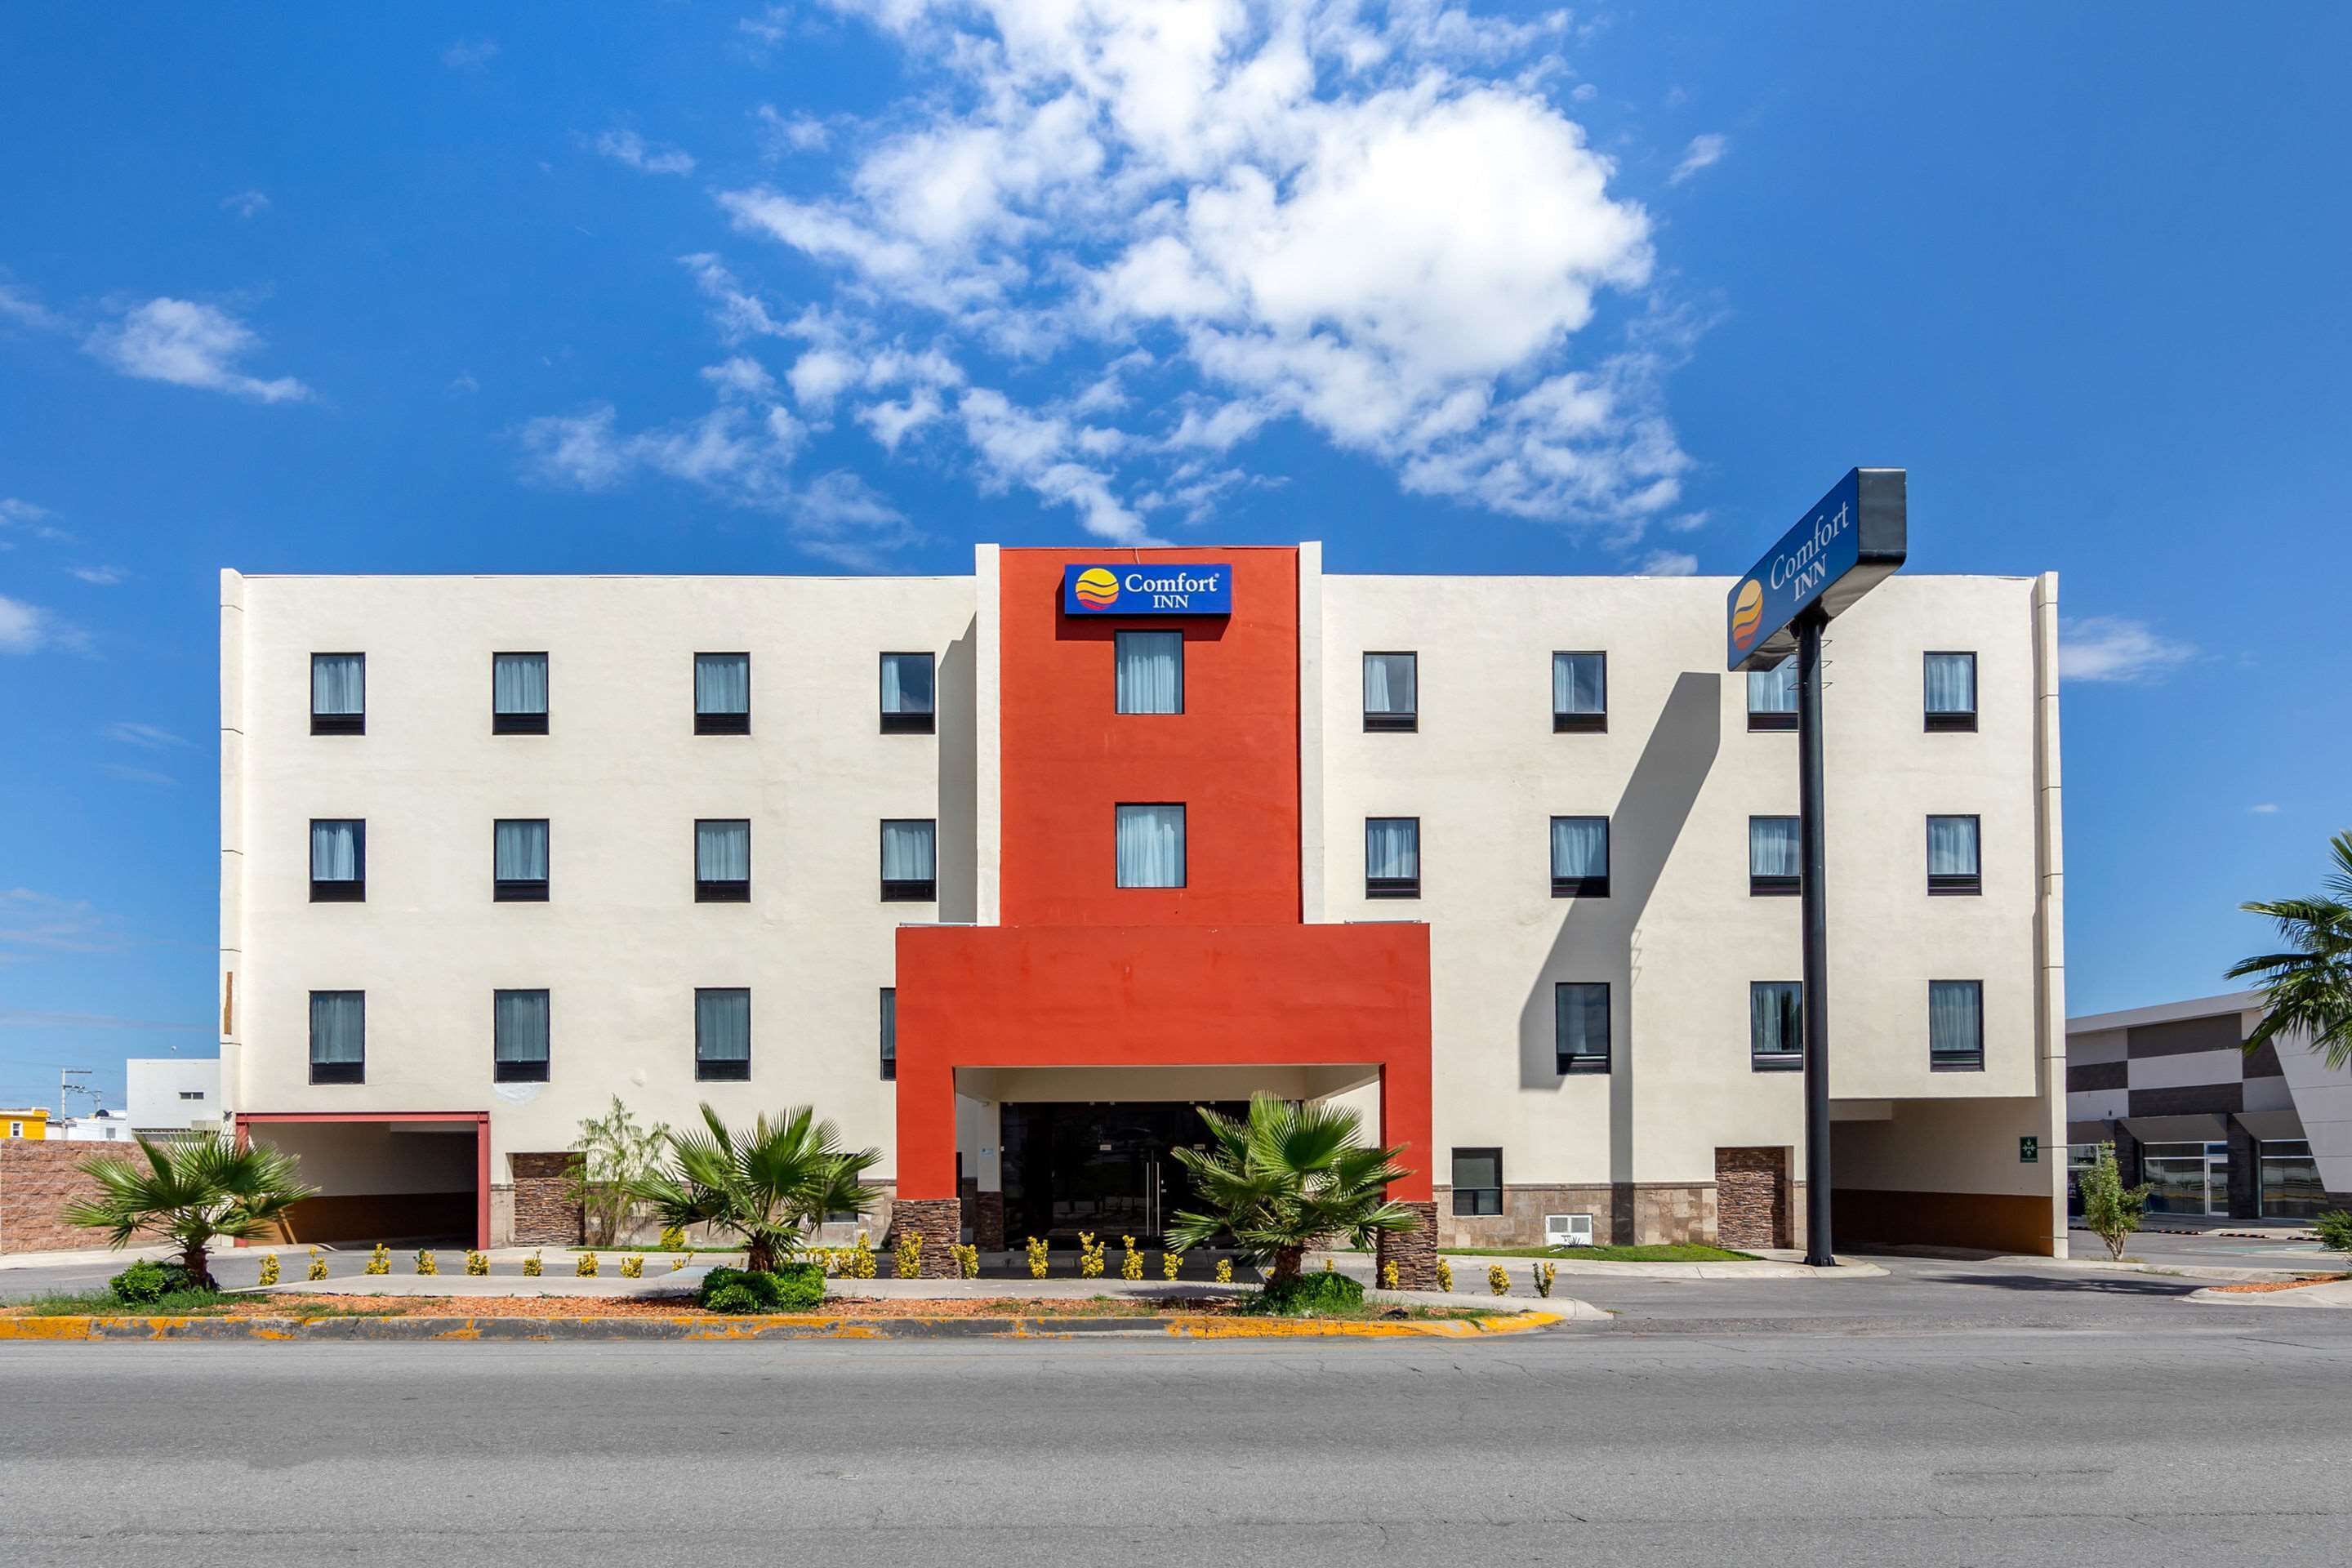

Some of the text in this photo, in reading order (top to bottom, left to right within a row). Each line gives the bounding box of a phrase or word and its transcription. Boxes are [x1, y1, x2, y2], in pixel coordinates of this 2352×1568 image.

[1771, 501, 1849, 590] Comfort
[1125, 572, 1218, 592] Comfort
[1793, 554, 1827, 602] INN
[1152, 595, 1189, 608] INN
